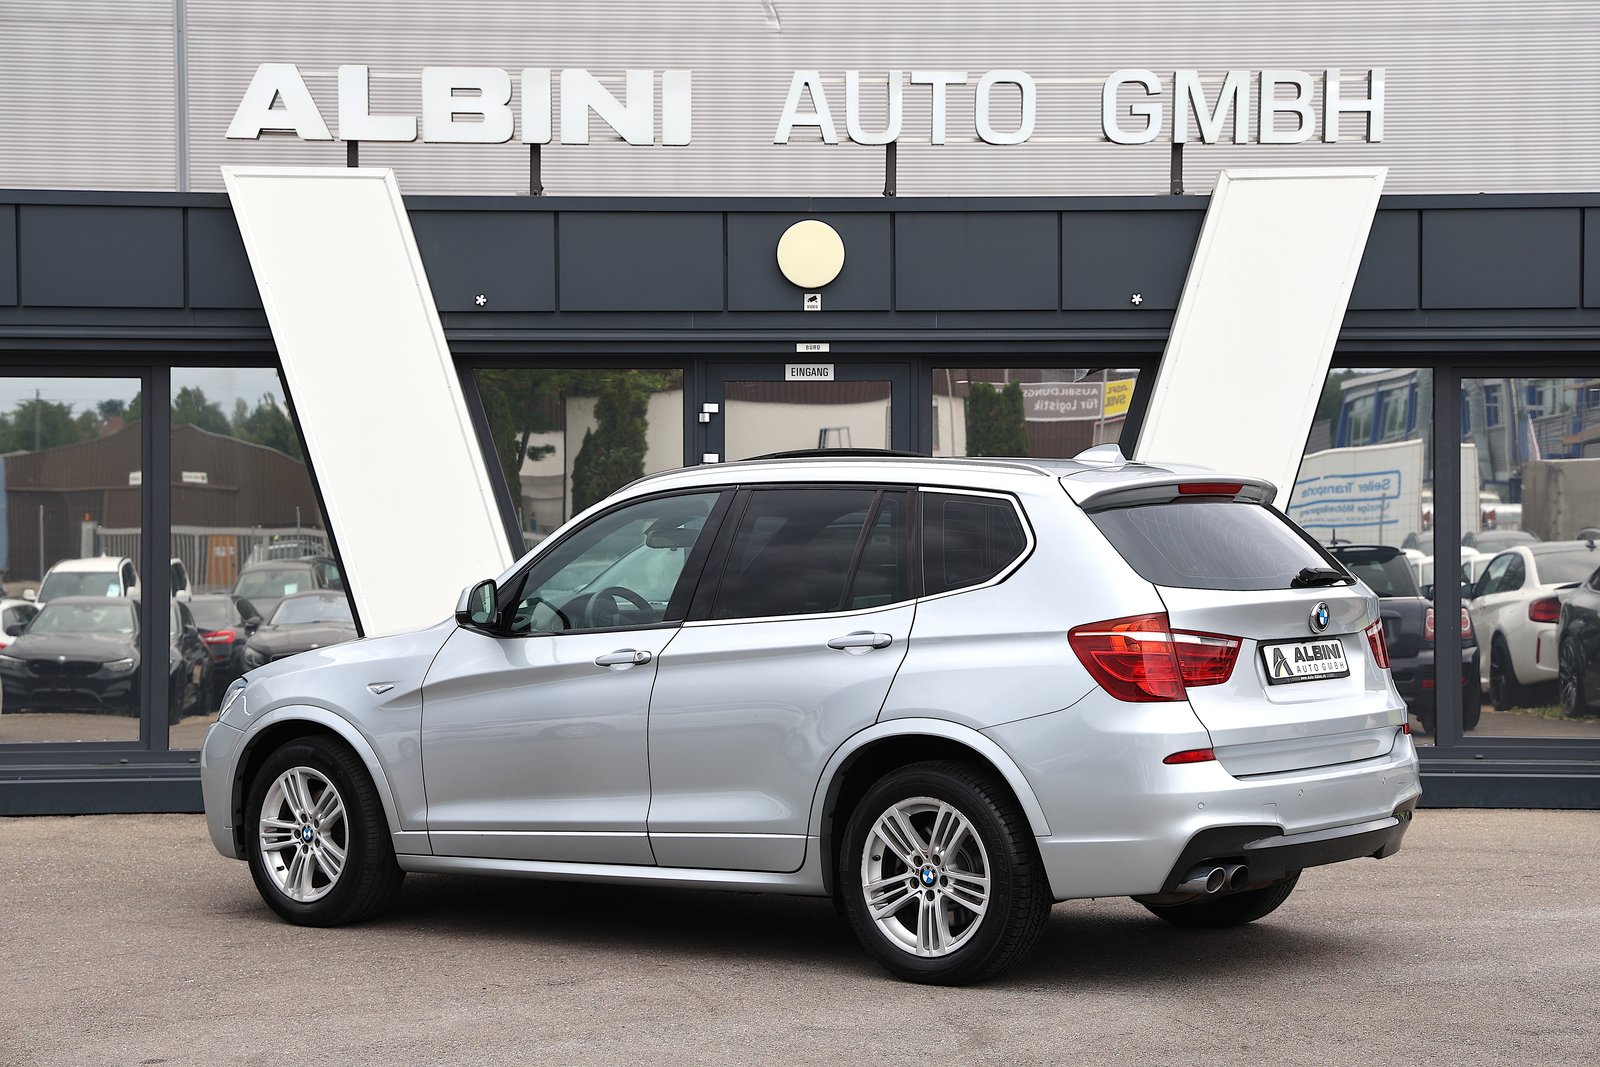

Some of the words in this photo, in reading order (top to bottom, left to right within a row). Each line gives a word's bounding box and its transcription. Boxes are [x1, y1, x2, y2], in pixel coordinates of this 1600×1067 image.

[225, 63, 693, 147] ALBINI
[773, 69, 1037, 146] AUTO
[1101, 68, 1386, 145] GMBH
[791, 367, 829, 377] EINGANG
[1294, 643, 1341, 662] ALBINI
[1296, 663, 1319, 674] AUTO
[1321, 661, 1345, 671] GMBH
